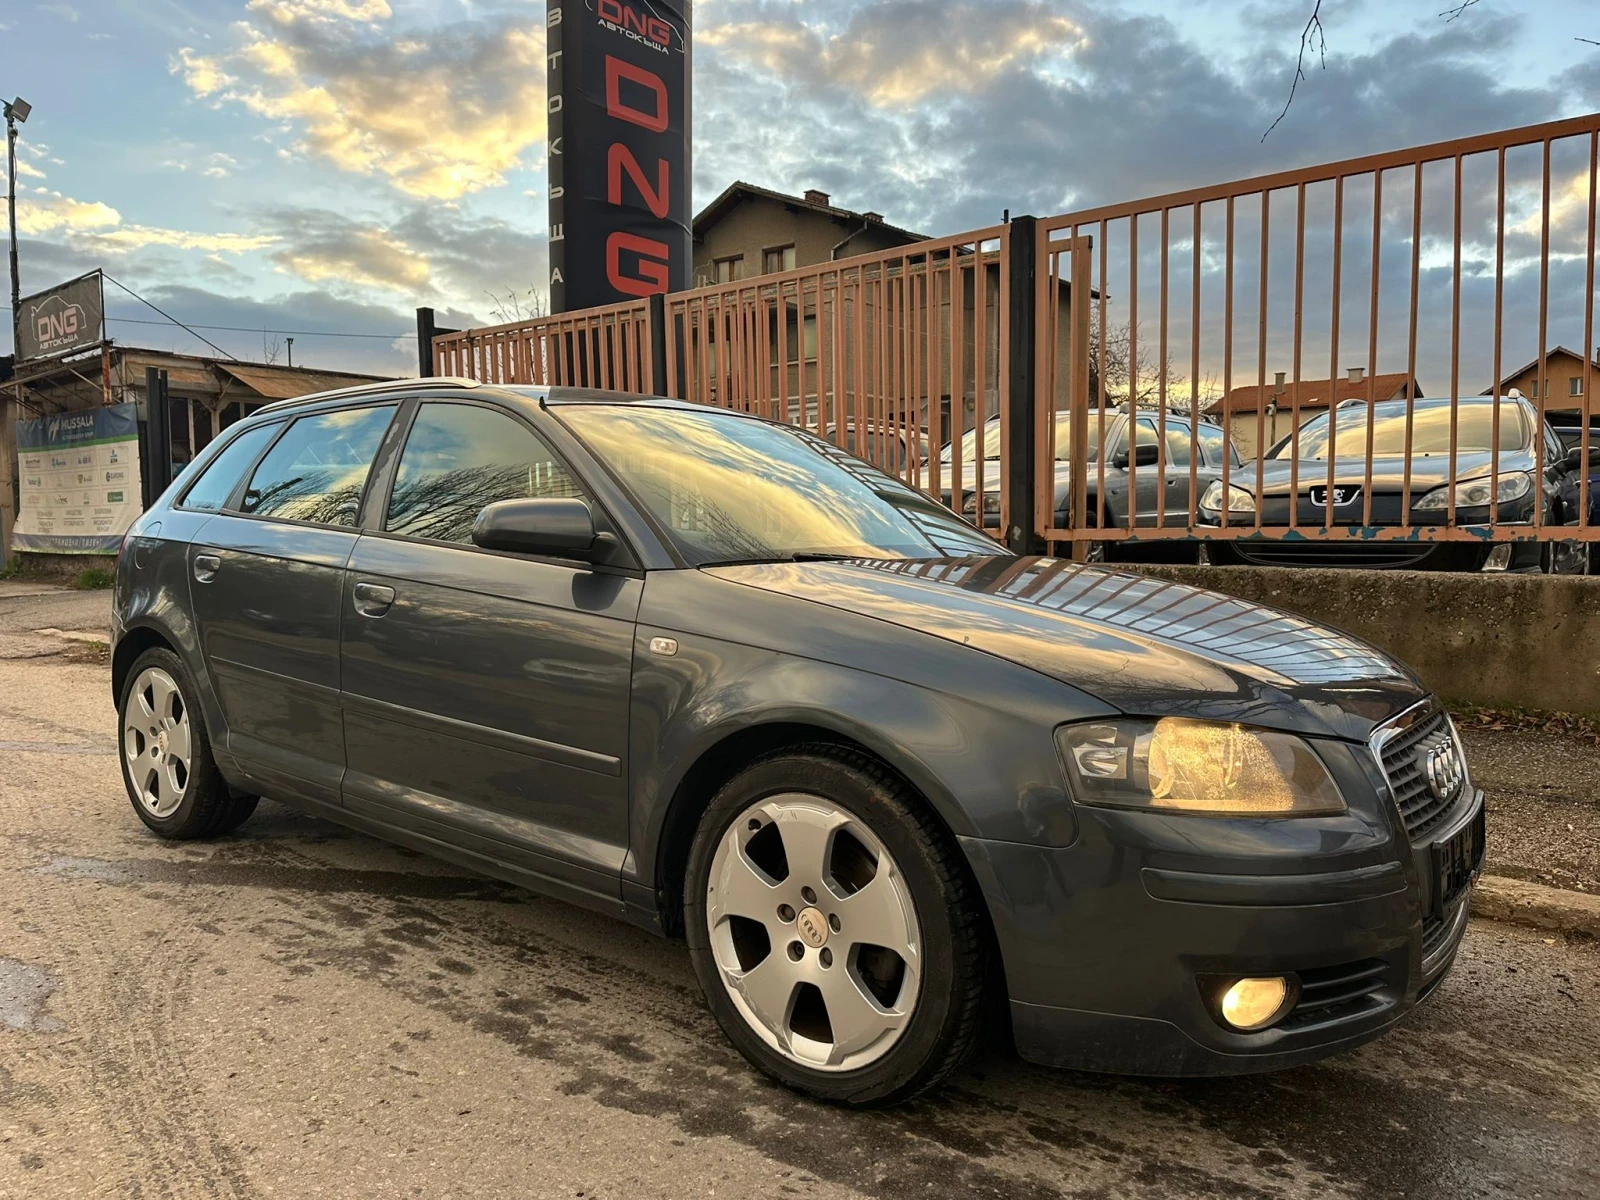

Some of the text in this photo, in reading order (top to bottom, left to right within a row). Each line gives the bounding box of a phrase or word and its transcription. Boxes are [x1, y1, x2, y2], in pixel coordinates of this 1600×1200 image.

[598, 0, 671, 46] DNG
[605, 54, 669, 298] DNG
[37, 306, 78, 342] DNG
[61, 415, 94, 430] MUSSALA
